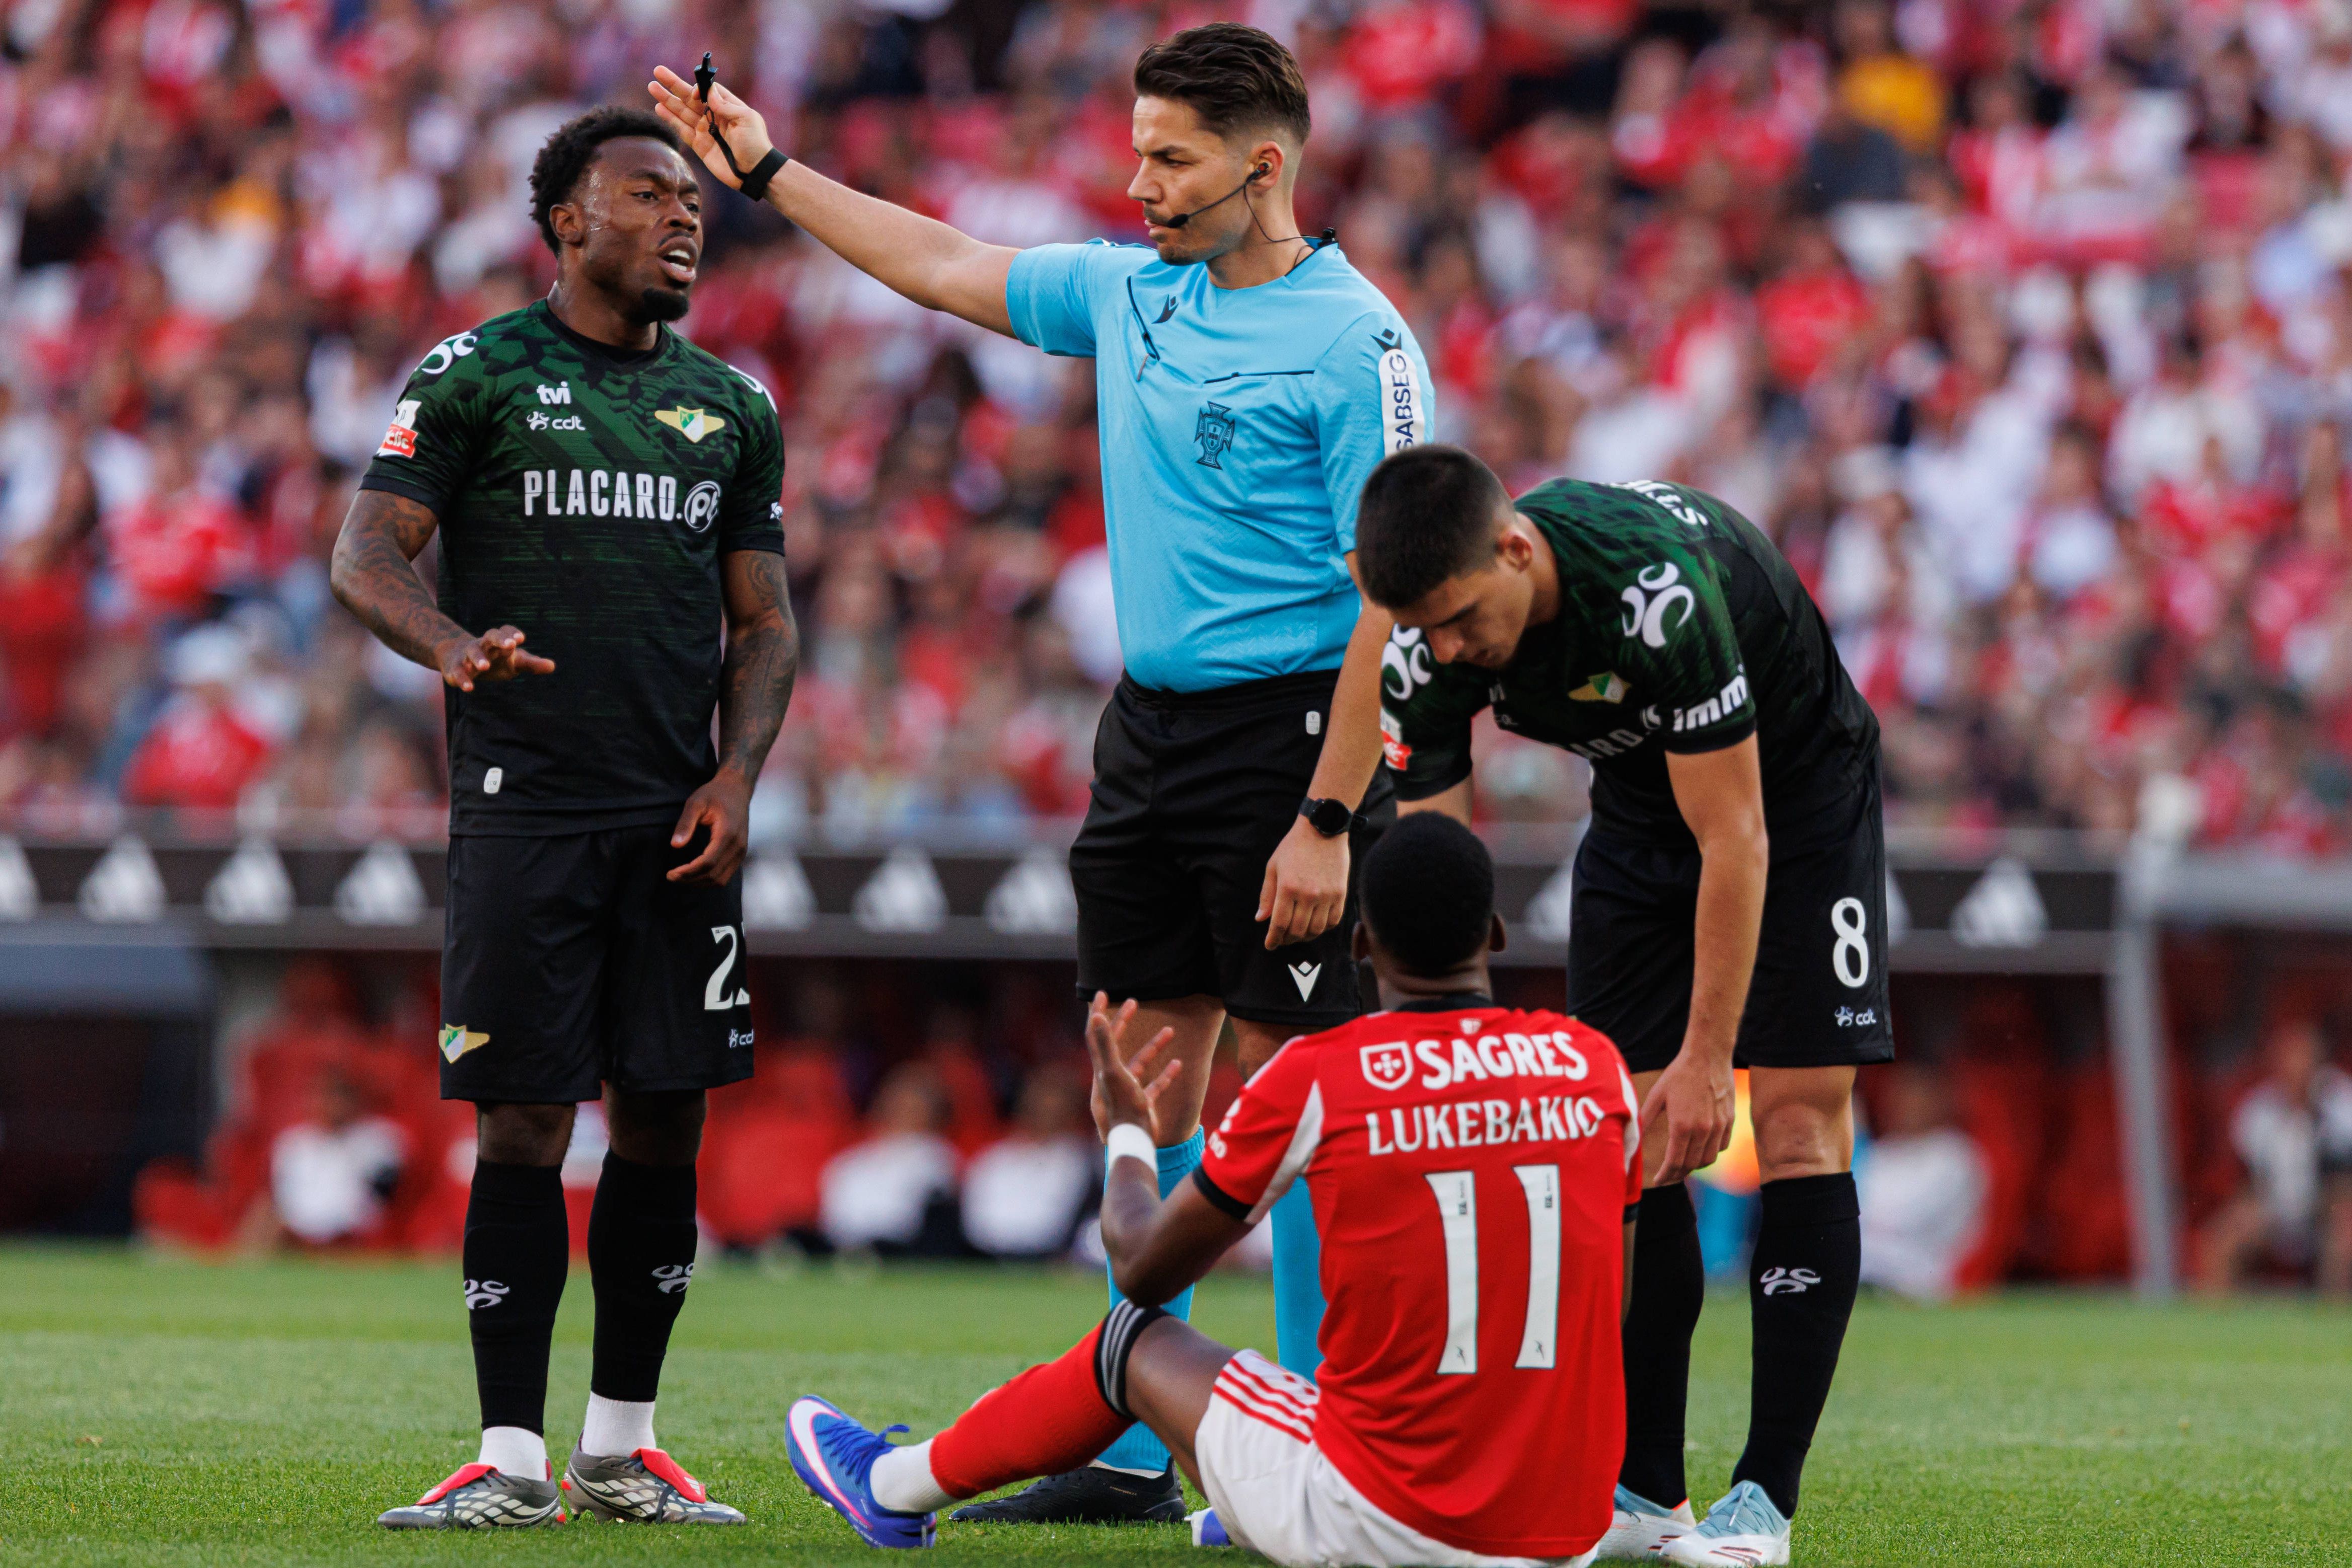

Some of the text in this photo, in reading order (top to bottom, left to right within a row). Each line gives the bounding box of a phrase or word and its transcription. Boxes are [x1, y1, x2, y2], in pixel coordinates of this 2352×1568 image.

[536, 381, 571, 404] tvi
[1389, 354, 1414, 452] SABSEG
[552, 415, 586, 431] cdt
[704, 924, 751, 1010] 2
[1831, 897, 1869, 989] 8
[739, 1028, 754, 1046] cd
[1855, 1008, 1877, 1026] cdt
[1415, 1030, 1588, 1090] SAGRES
[1365, 1096, 1605, 1156] LUKEBAKIO
[1424, 1164, 1560, 1375] 11
